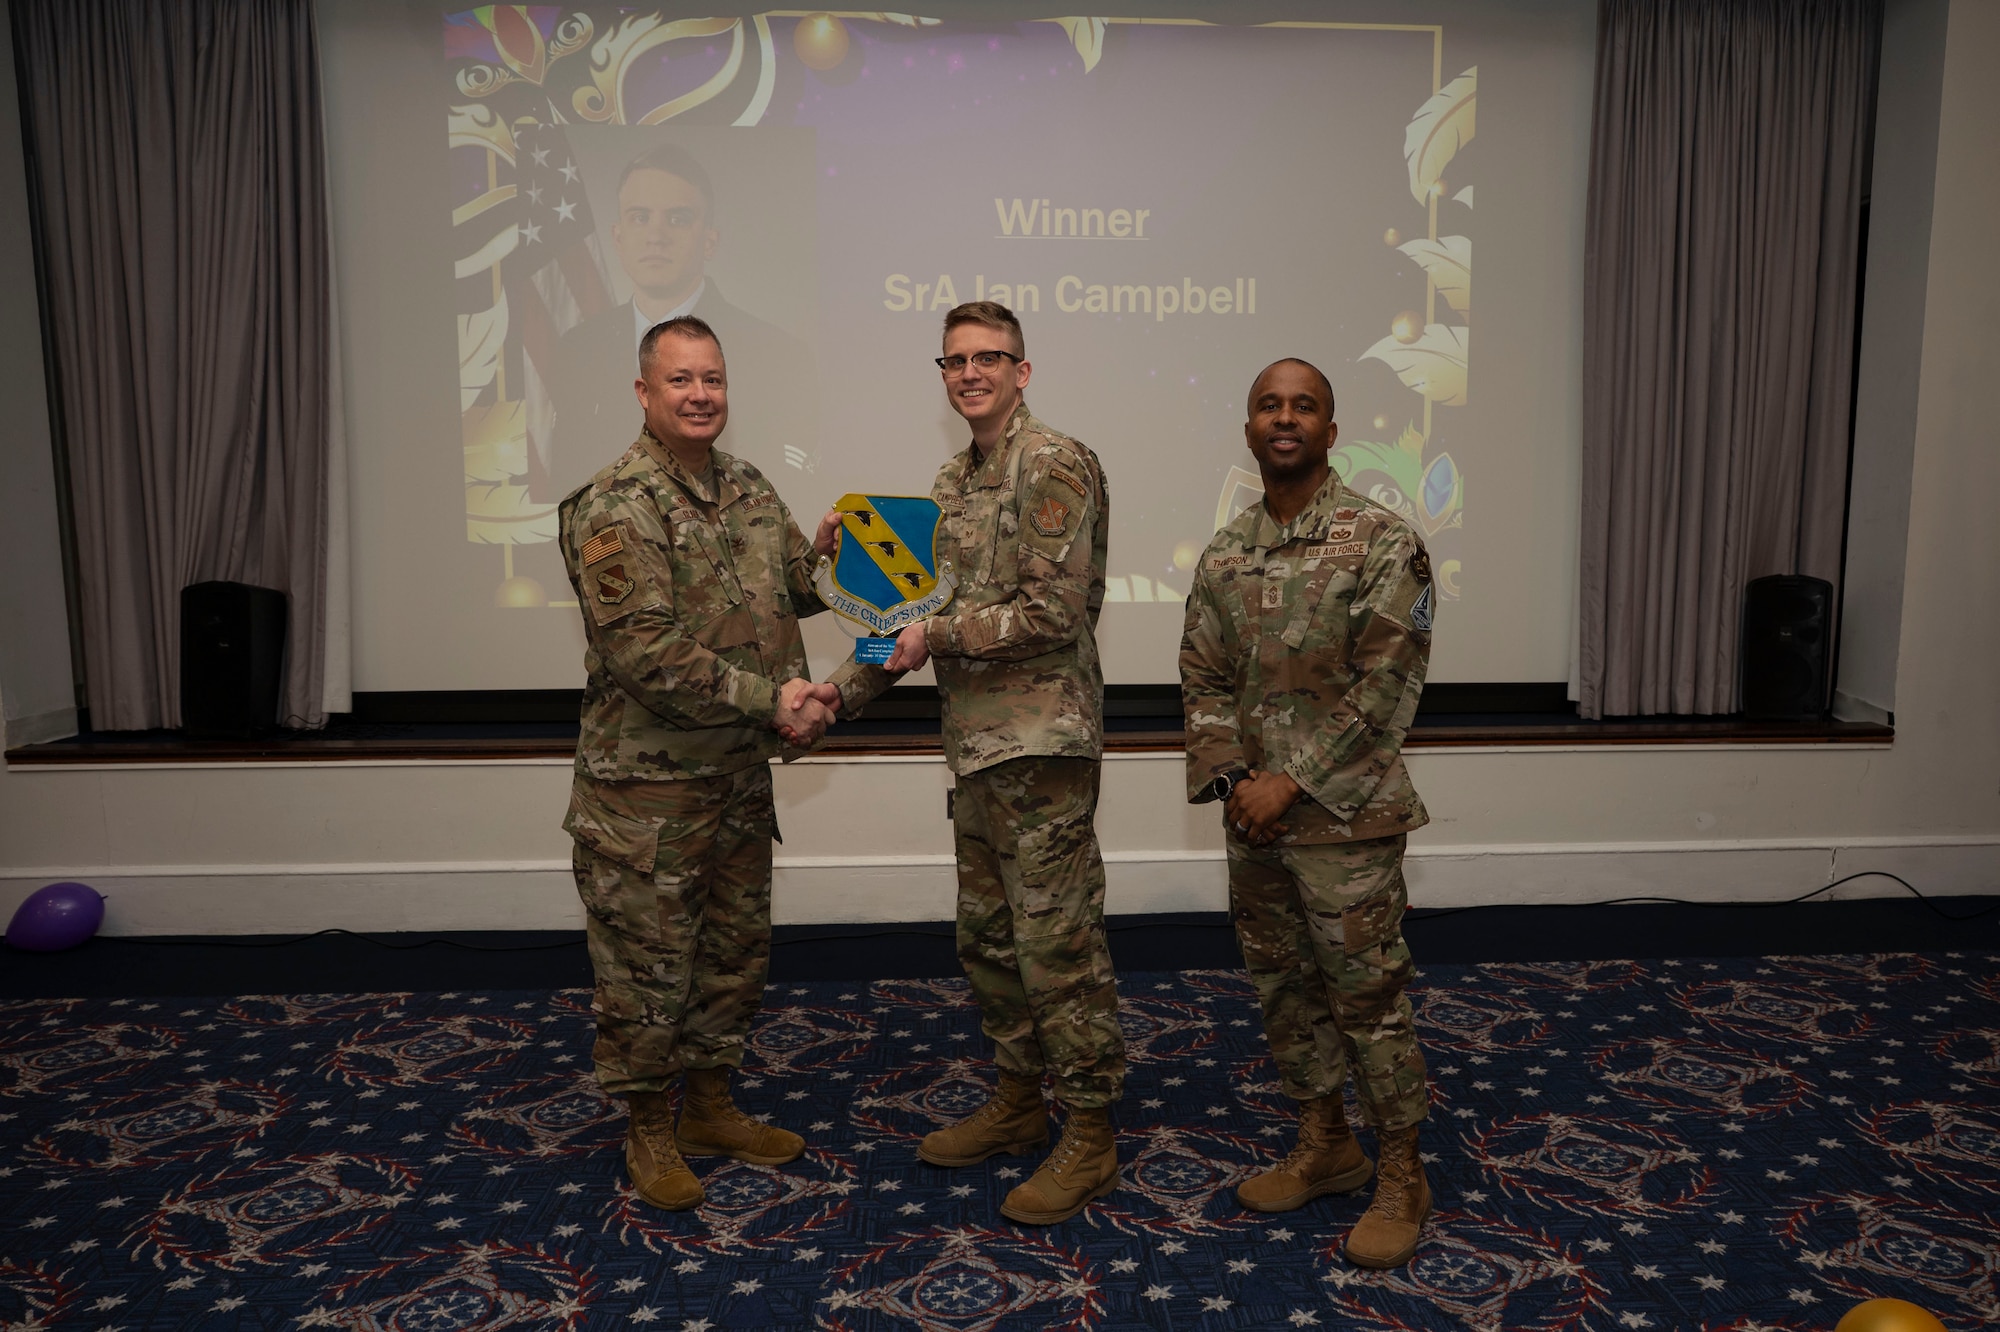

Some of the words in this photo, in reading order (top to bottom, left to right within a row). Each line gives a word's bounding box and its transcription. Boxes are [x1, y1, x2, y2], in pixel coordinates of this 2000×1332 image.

[994, 198, 1151, 237] Winner
[883, 274, 959, 312] SrA
[975, 275, 1040, 312] Ian
[1055, 275, 1257, 322] Campbell
[1323, 545, 1338, 556] AIR
[1338, 543, 1364, 555] FORCE
[834, 595, 860, 616] THE
[860, 607, 910, 631] CHIEF'S
[911, 595, 943, 618] OWN
